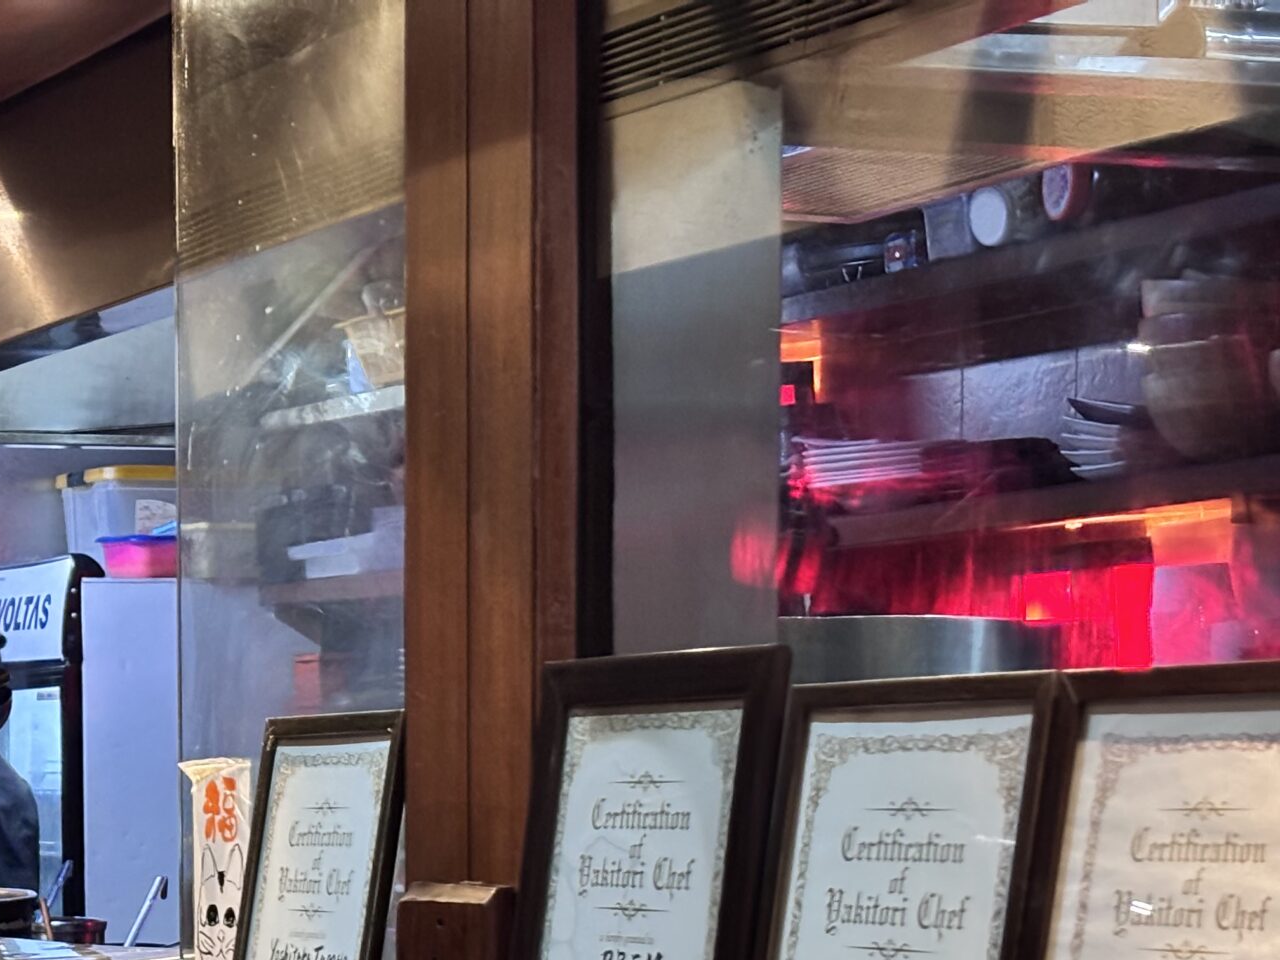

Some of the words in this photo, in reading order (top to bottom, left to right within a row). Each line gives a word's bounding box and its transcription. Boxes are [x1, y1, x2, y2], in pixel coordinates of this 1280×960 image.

[592, 798, 692, 830] Certification
[289, 821, 353, 847] Certification
[629, 833, 646, 859] of
[841, 826, 967, 863] Certification
[1130, 827, 1269, 863] Certification
[312, 849, 324, 870] of
[326, 868, 354, 903] Chef
[578, 854, 646, 899] Yakitori
[653, 857, 697, 902] Chef
[887, 867, 911, 894] of
[1181, 868, 1207, 896] of
[826, 887, 908, 936] Yakitori
[917, 892, 972, 942] Chef
[1215, 893, 1273, 942] Chef
